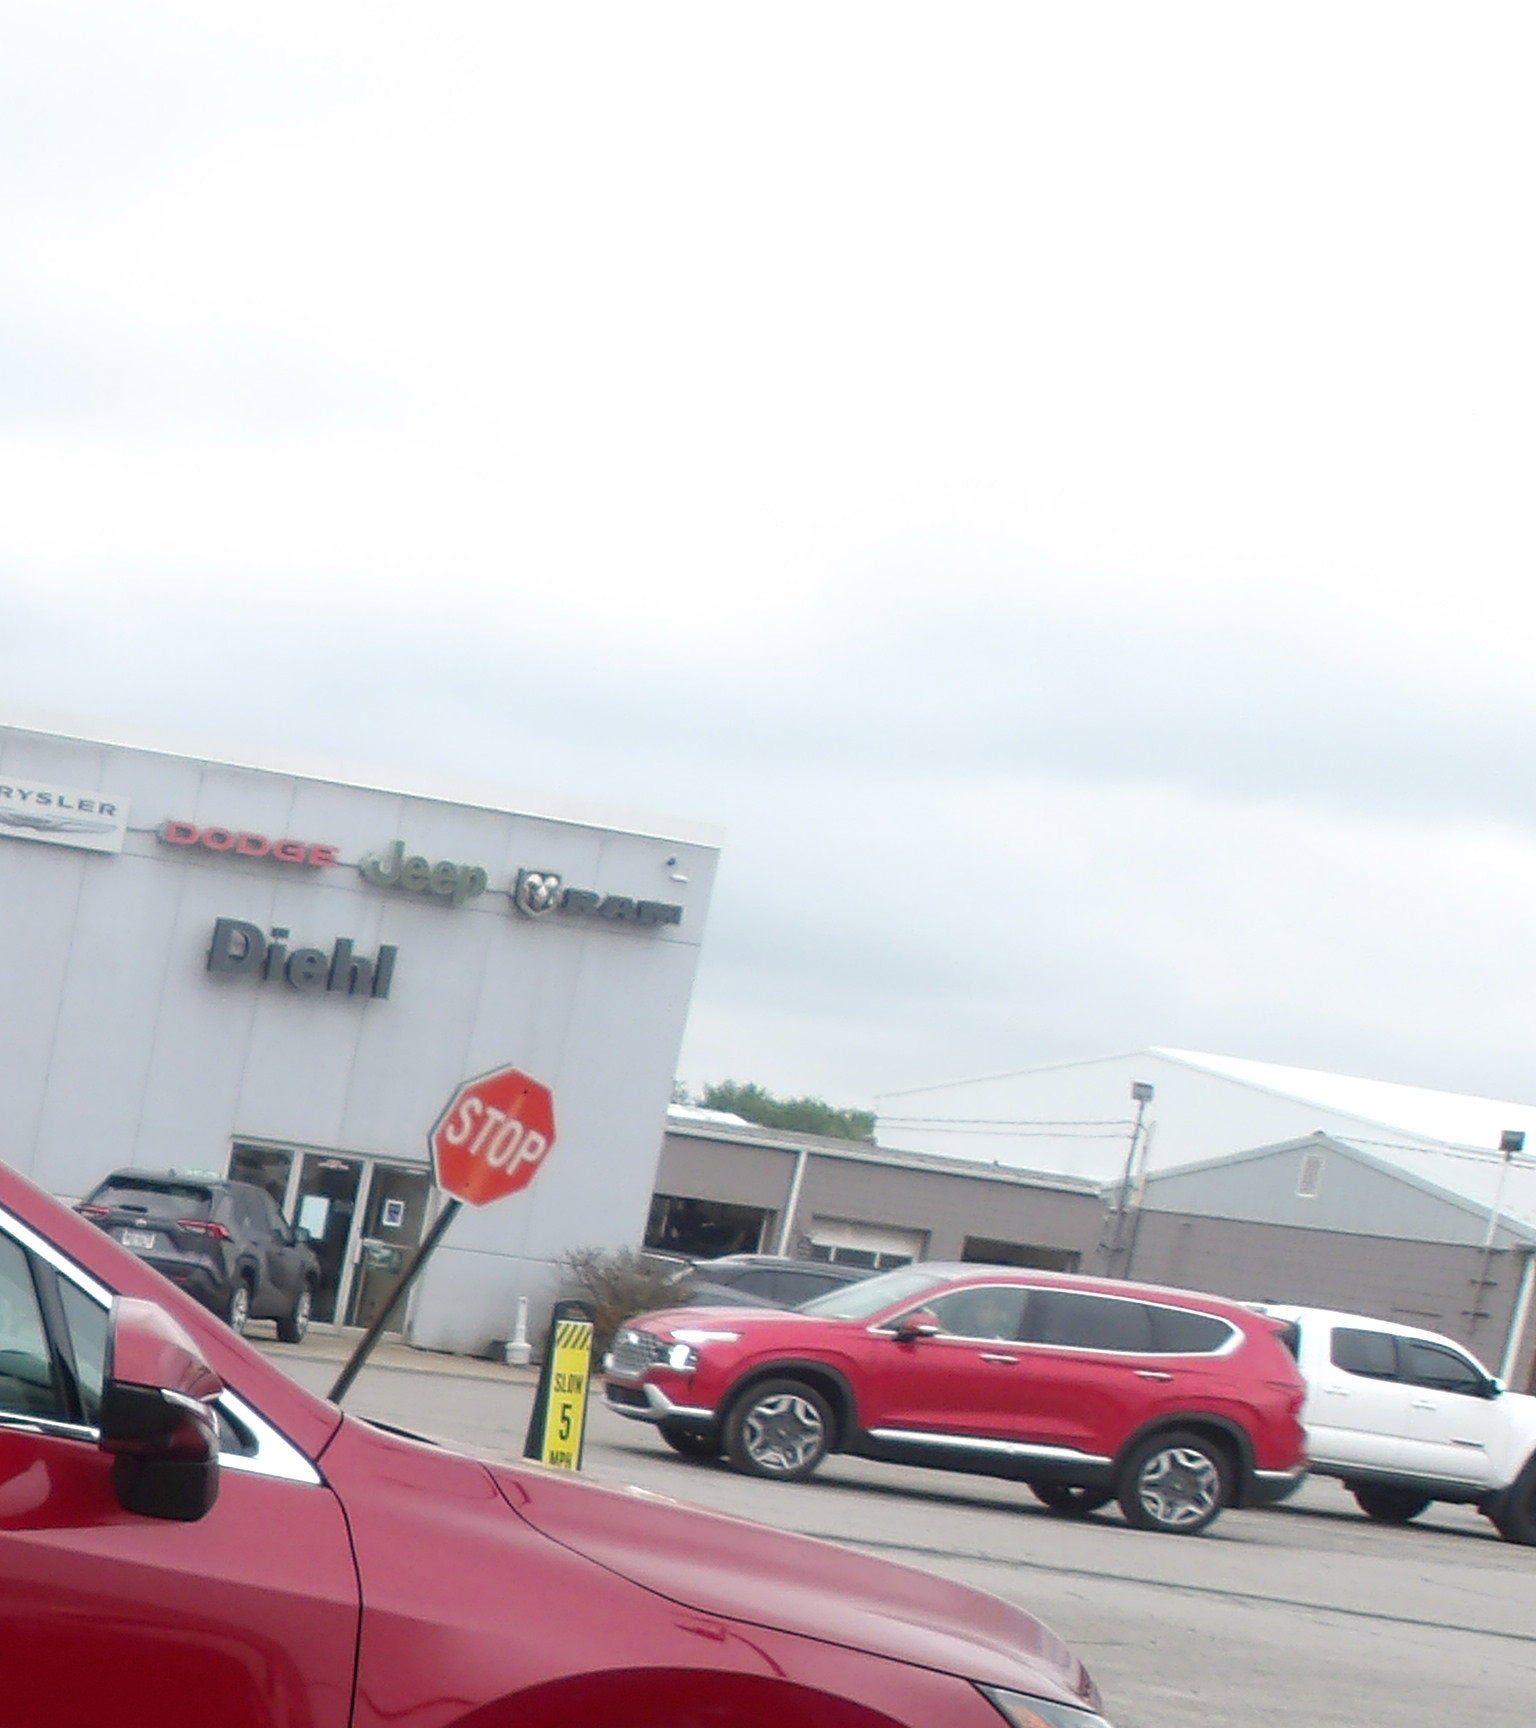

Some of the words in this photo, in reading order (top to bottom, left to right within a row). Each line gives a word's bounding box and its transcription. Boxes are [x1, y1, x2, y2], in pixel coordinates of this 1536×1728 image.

[163, 821, 341, 868] DODGE
[362, 840, 490, 905] Jeep
[562, 886, 684, 926] RAM
[206, 915, 399, 1000] Diehl
[444, 1097, 547, 1176] STOP
[559, 1402, 573, 1441] 5
